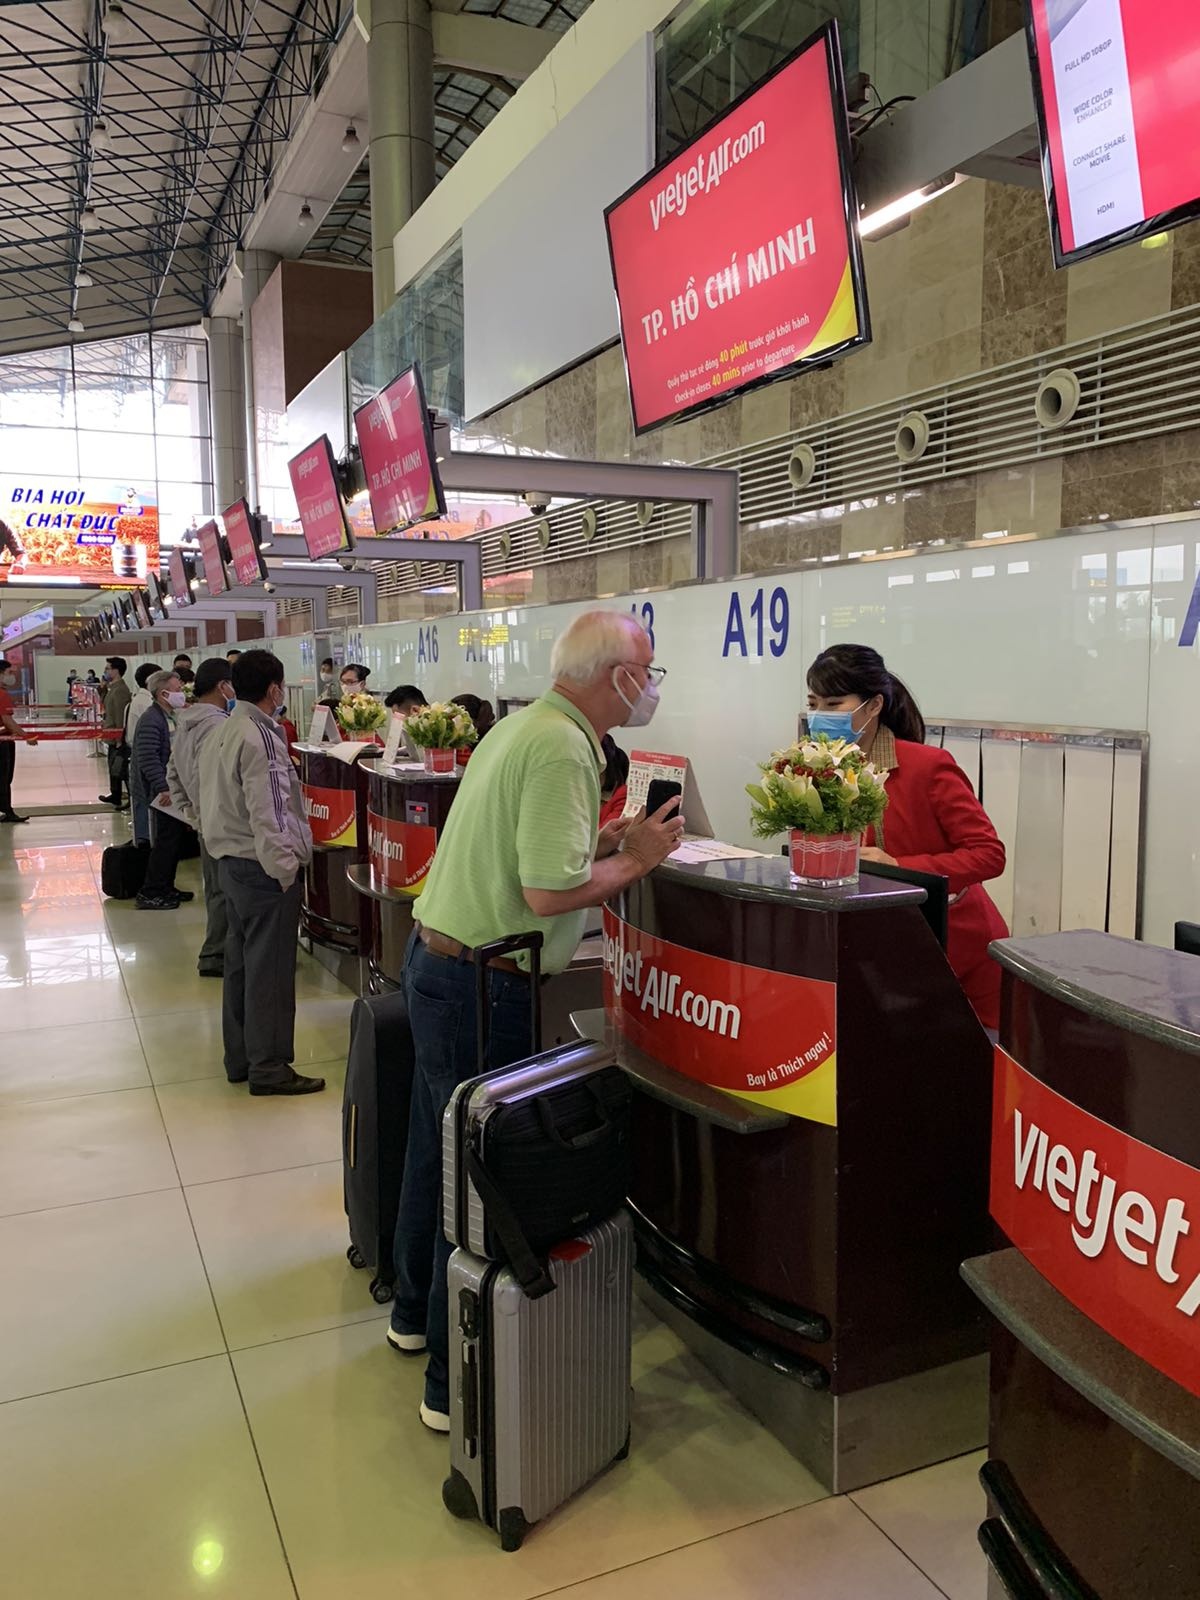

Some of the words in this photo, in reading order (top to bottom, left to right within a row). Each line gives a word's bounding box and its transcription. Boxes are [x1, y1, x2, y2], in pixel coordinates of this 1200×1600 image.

[1064, 57, 1081, 73] FULL
[1080, 51, 1091, 63] HD
[1091, 38, 1113, 56] 1080P
[1073, 99, 1091, 115] WIDE
[1091, 87, 1114, 105] COLOR
[1076, 98, 1113, 124] ENHANCER
[1072, 146, 1103, 167] CONNECT
[1103, 134, 1127, 152] SHARE
[1089, 152, 1112, 168] MOVIE
[1096, 201, 1115, 215] HDMI
[641, 308, 668, 345] TP.
[670, 276, 700, 330] HỒ
[704, 251, 742, 310] CHÍ
[746, 217, 817, 288] MINH
[711, 373, 721, 387] 40
[722, 365, 741, 382] mins
[740, 362, 756, 377] prior
[756, 358, 764, 369] to
[764, 344, 796, 365] departure
[719, 350, 729, 363] 40
[729, 340, 748, 361] phút
[11, 487, 44, 504] BIA
[722, 586, 790, 657] A19
[417, 624, 439, 664] A16
[746, 1073, 766, 1087] Bay
[767, 1067, 778, 1082] là
[777, 1056, 806, 1077] Thích
